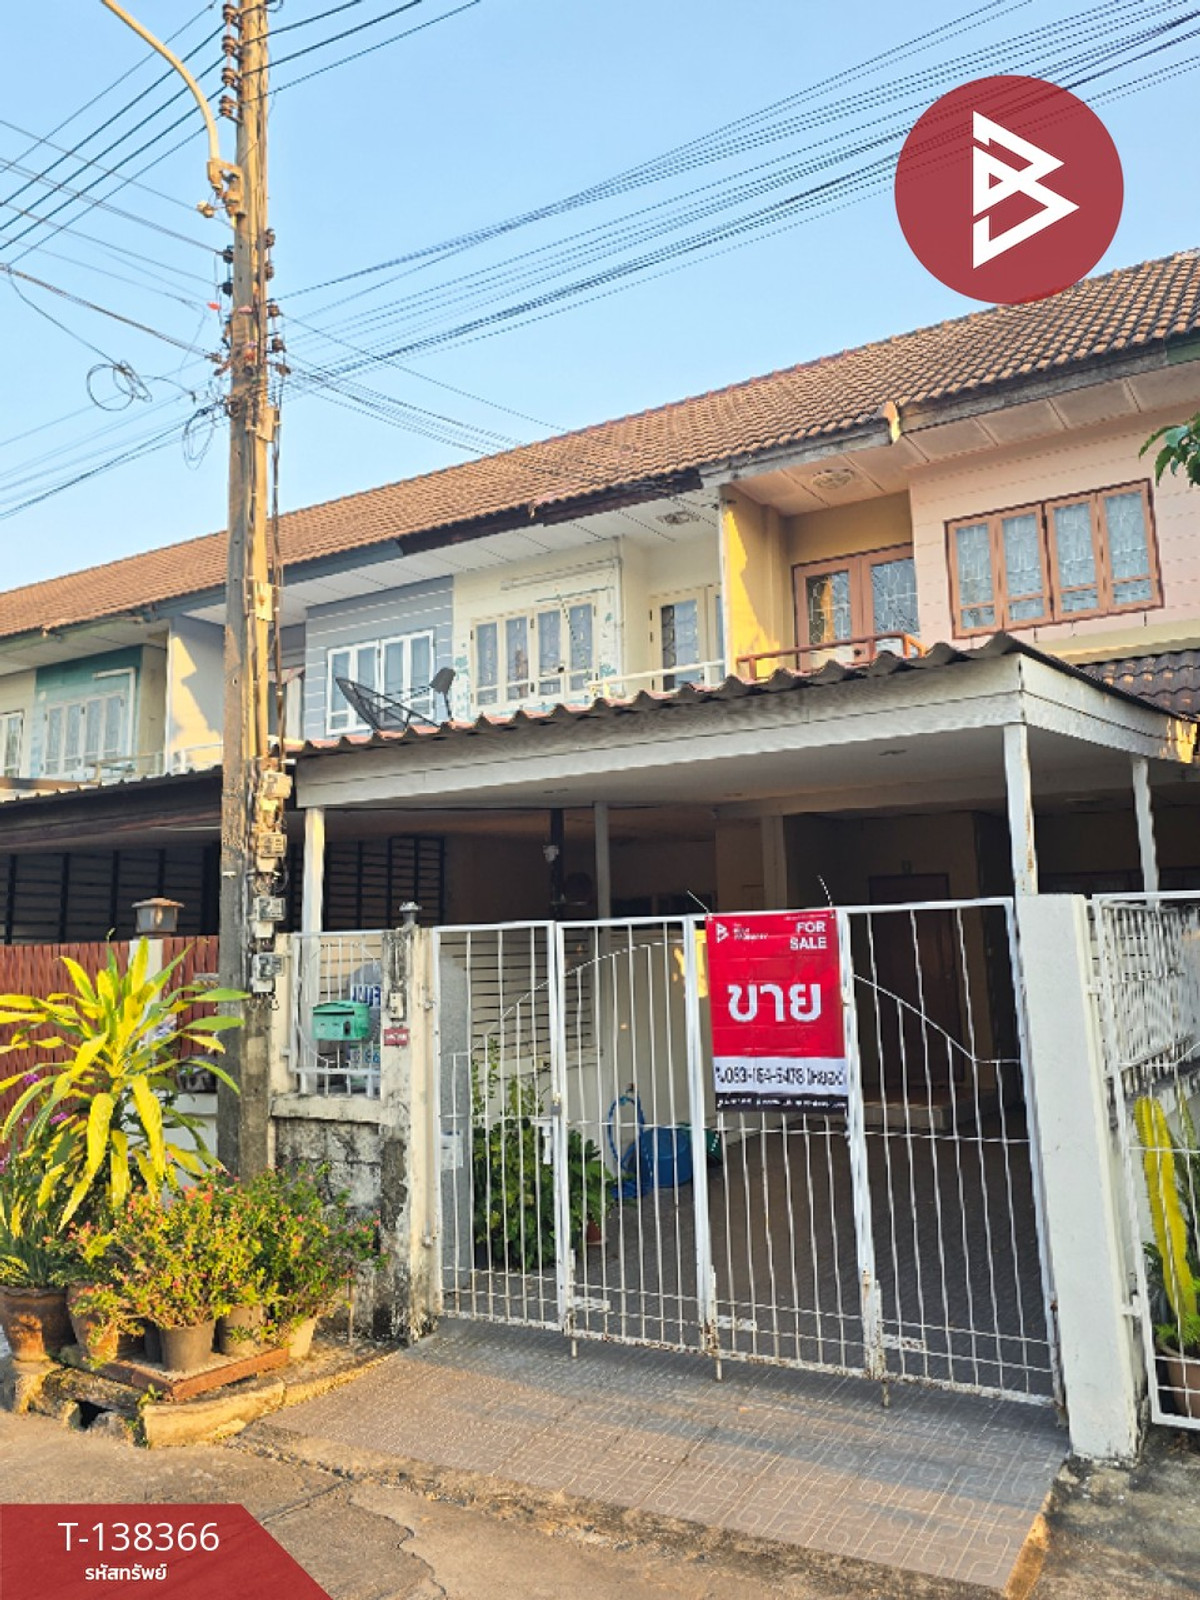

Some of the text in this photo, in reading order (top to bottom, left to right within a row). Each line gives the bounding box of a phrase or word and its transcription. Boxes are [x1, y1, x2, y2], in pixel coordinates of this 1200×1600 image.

[796, 920, 826, 935] FOR
[789, 936, 827, 950] SALE
[727, 983, 822, 1022] ขาย
